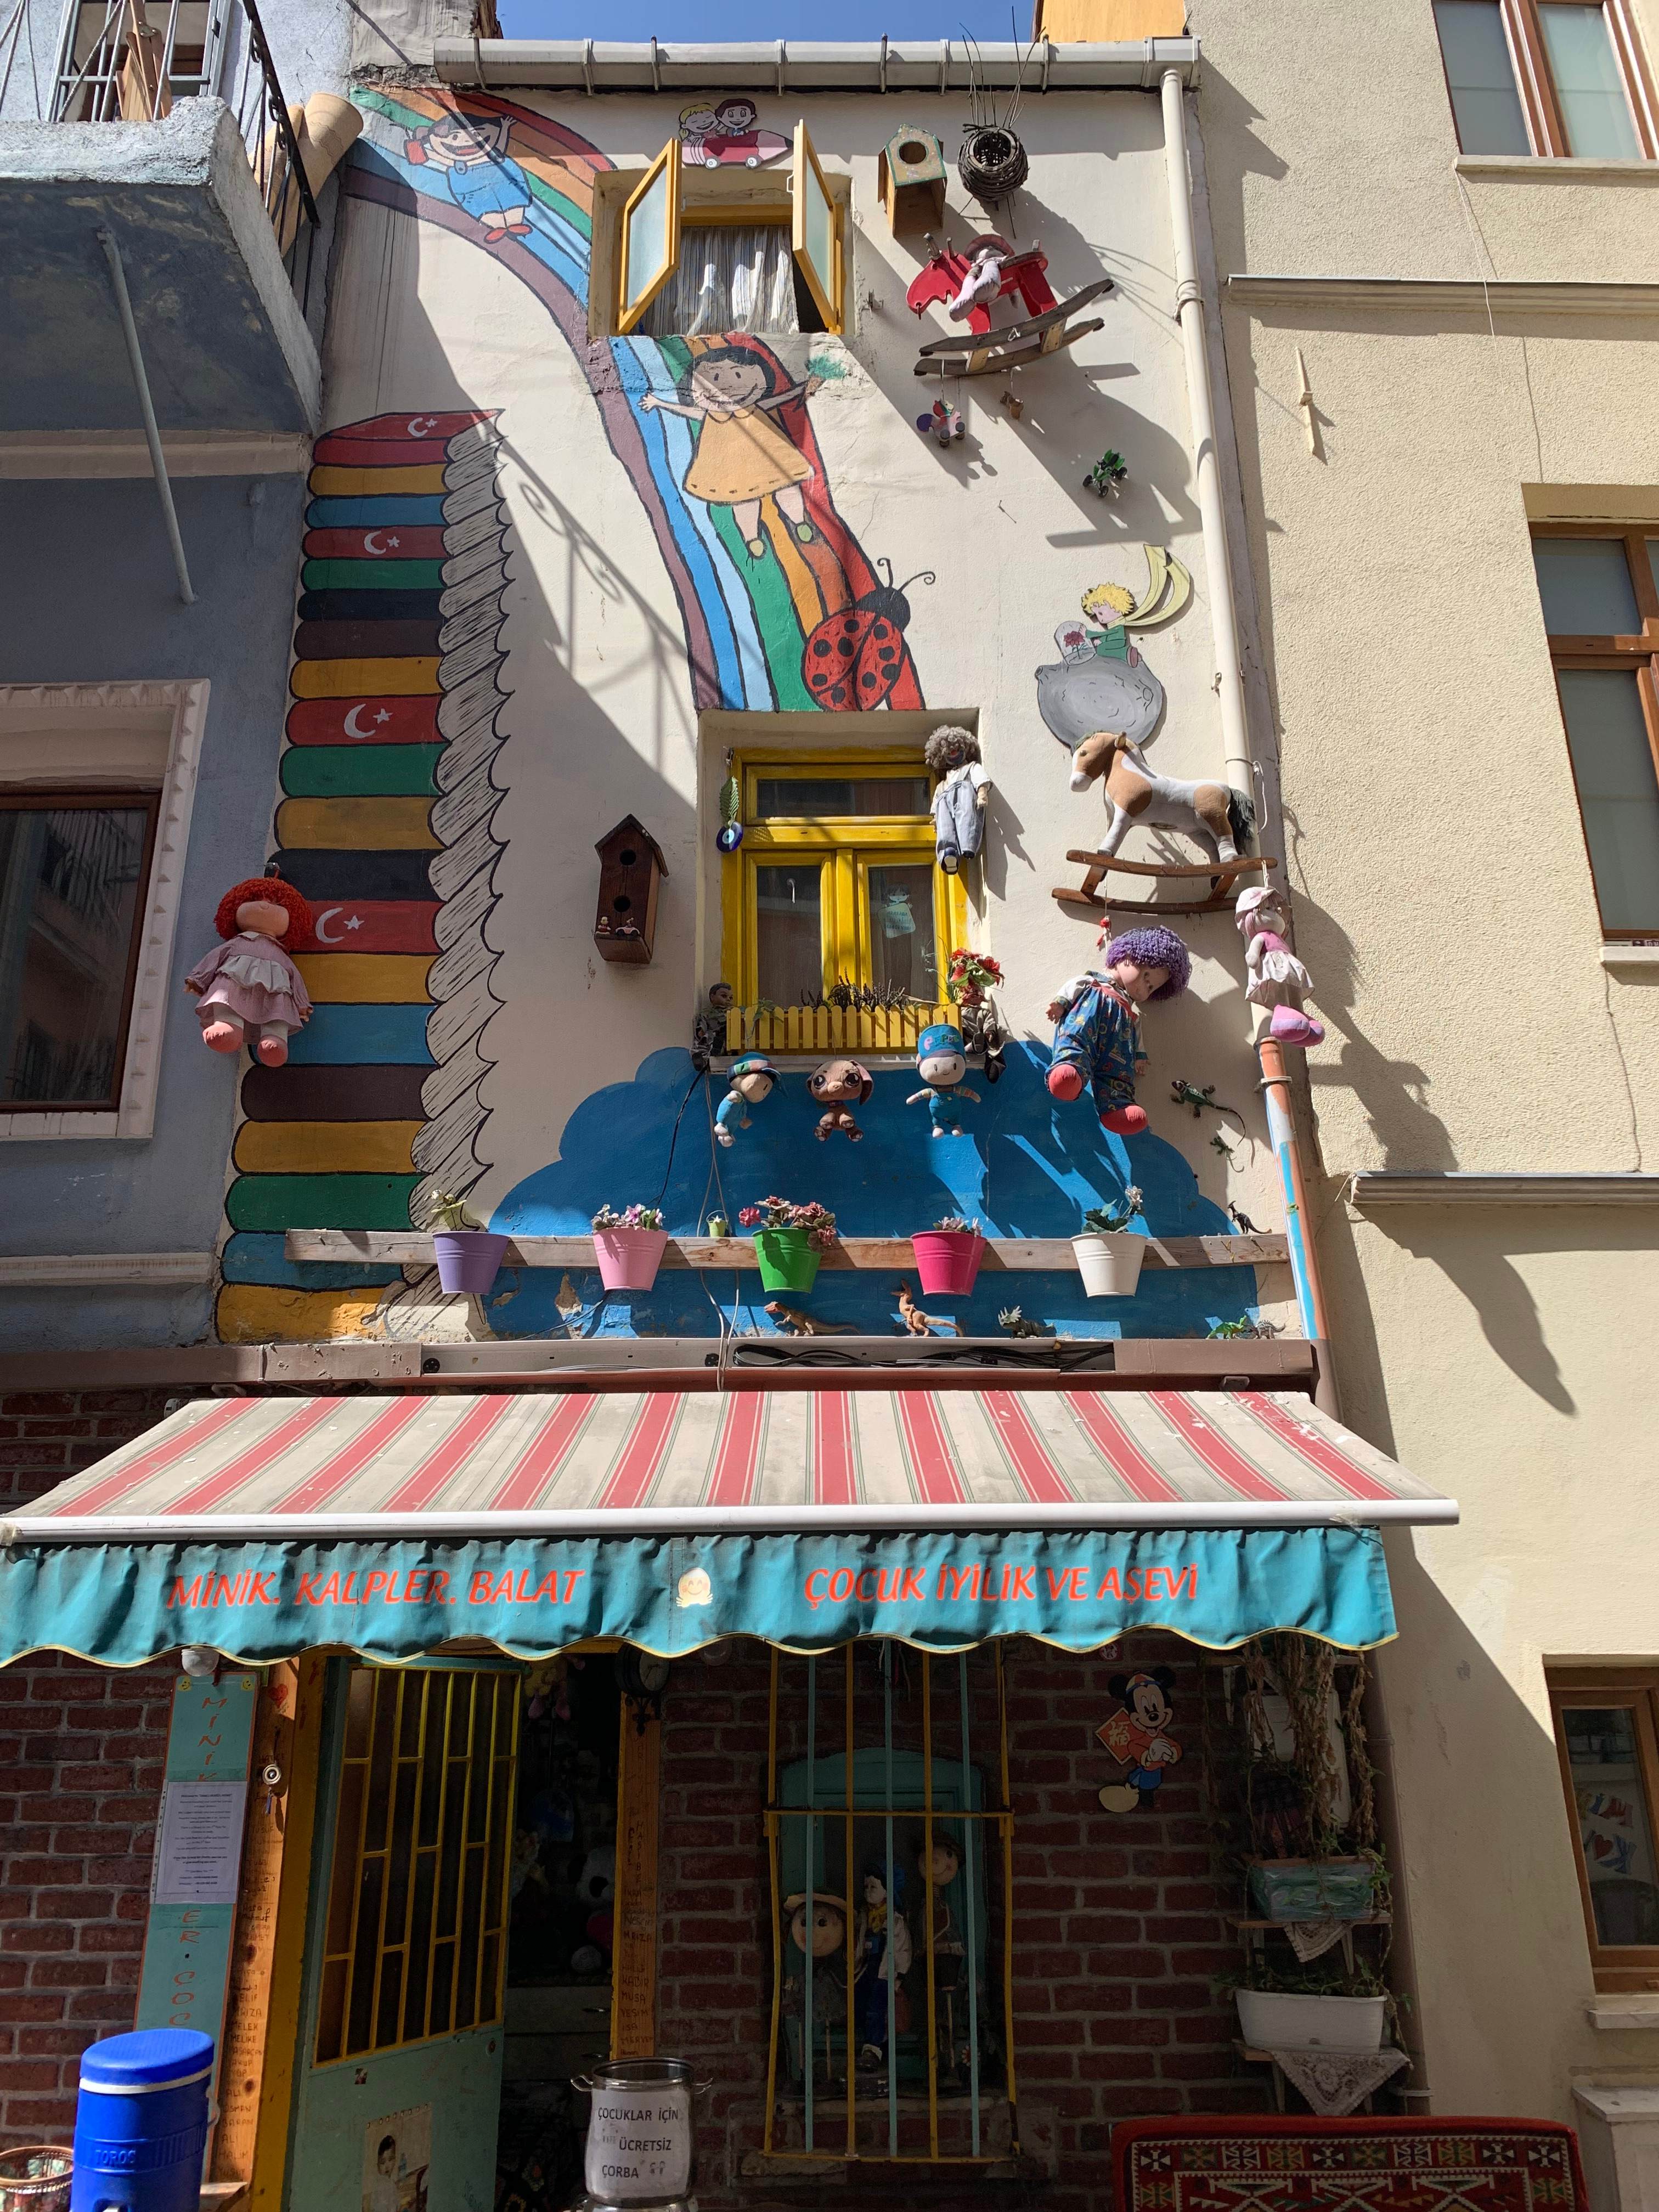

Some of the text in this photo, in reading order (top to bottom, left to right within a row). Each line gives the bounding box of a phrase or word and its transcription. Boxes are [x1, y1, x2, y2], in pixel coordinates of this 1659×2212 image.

[294, 1568, 456, 1606] KALPLER.
[468, 1567, 586, 1605] BALAT
[804, 1562, 1198, 1610] ÇOCUK İYİLİK VE AŞEVİ
[598, 2107, 679, 2123] ÇOCUKLAR İÇİN
[619, 2137, 672, 2151] ÜCRETSİZ
[95, 2149, 137, 2165] TOROS
[602, 2165, 639, 2179] ÇORBA
